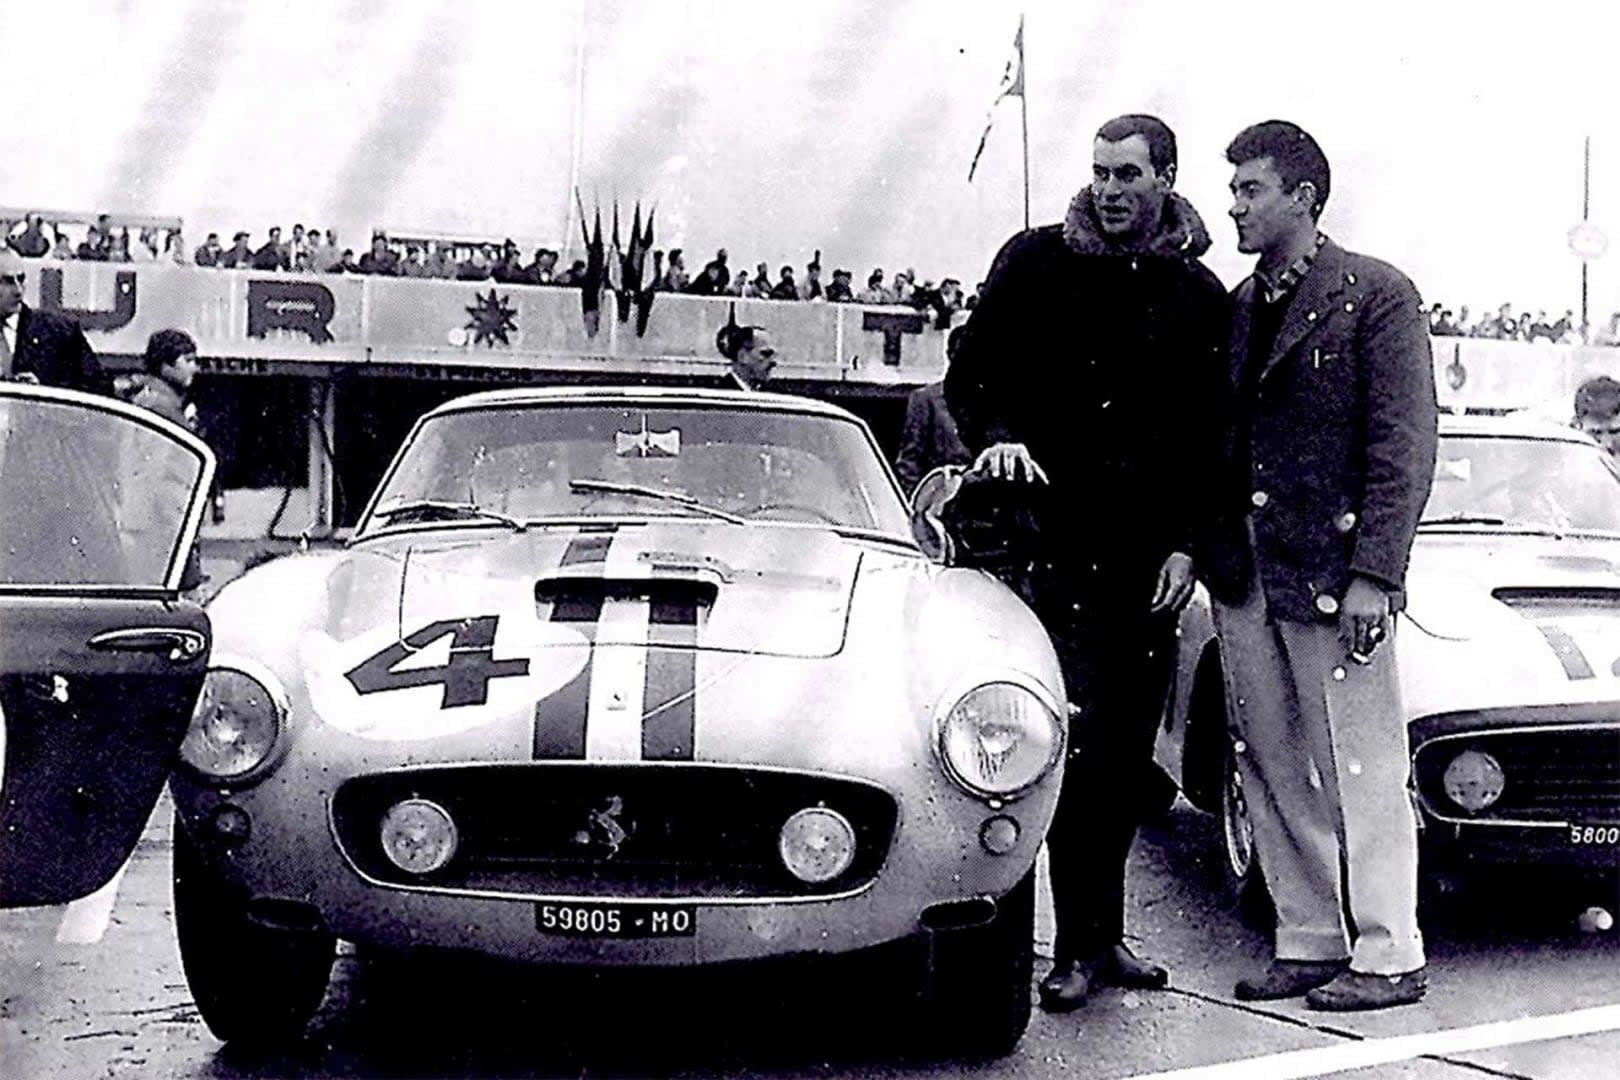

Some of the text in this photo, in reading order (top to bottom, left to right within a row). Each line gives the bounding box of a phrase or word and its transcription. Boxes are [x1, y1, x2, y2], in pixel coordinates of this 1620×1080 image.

[343, 615, 530, 709] 4
[1570, 825, 1619, 844] 5800
[542, 905, 689, 933] 59805 MO
